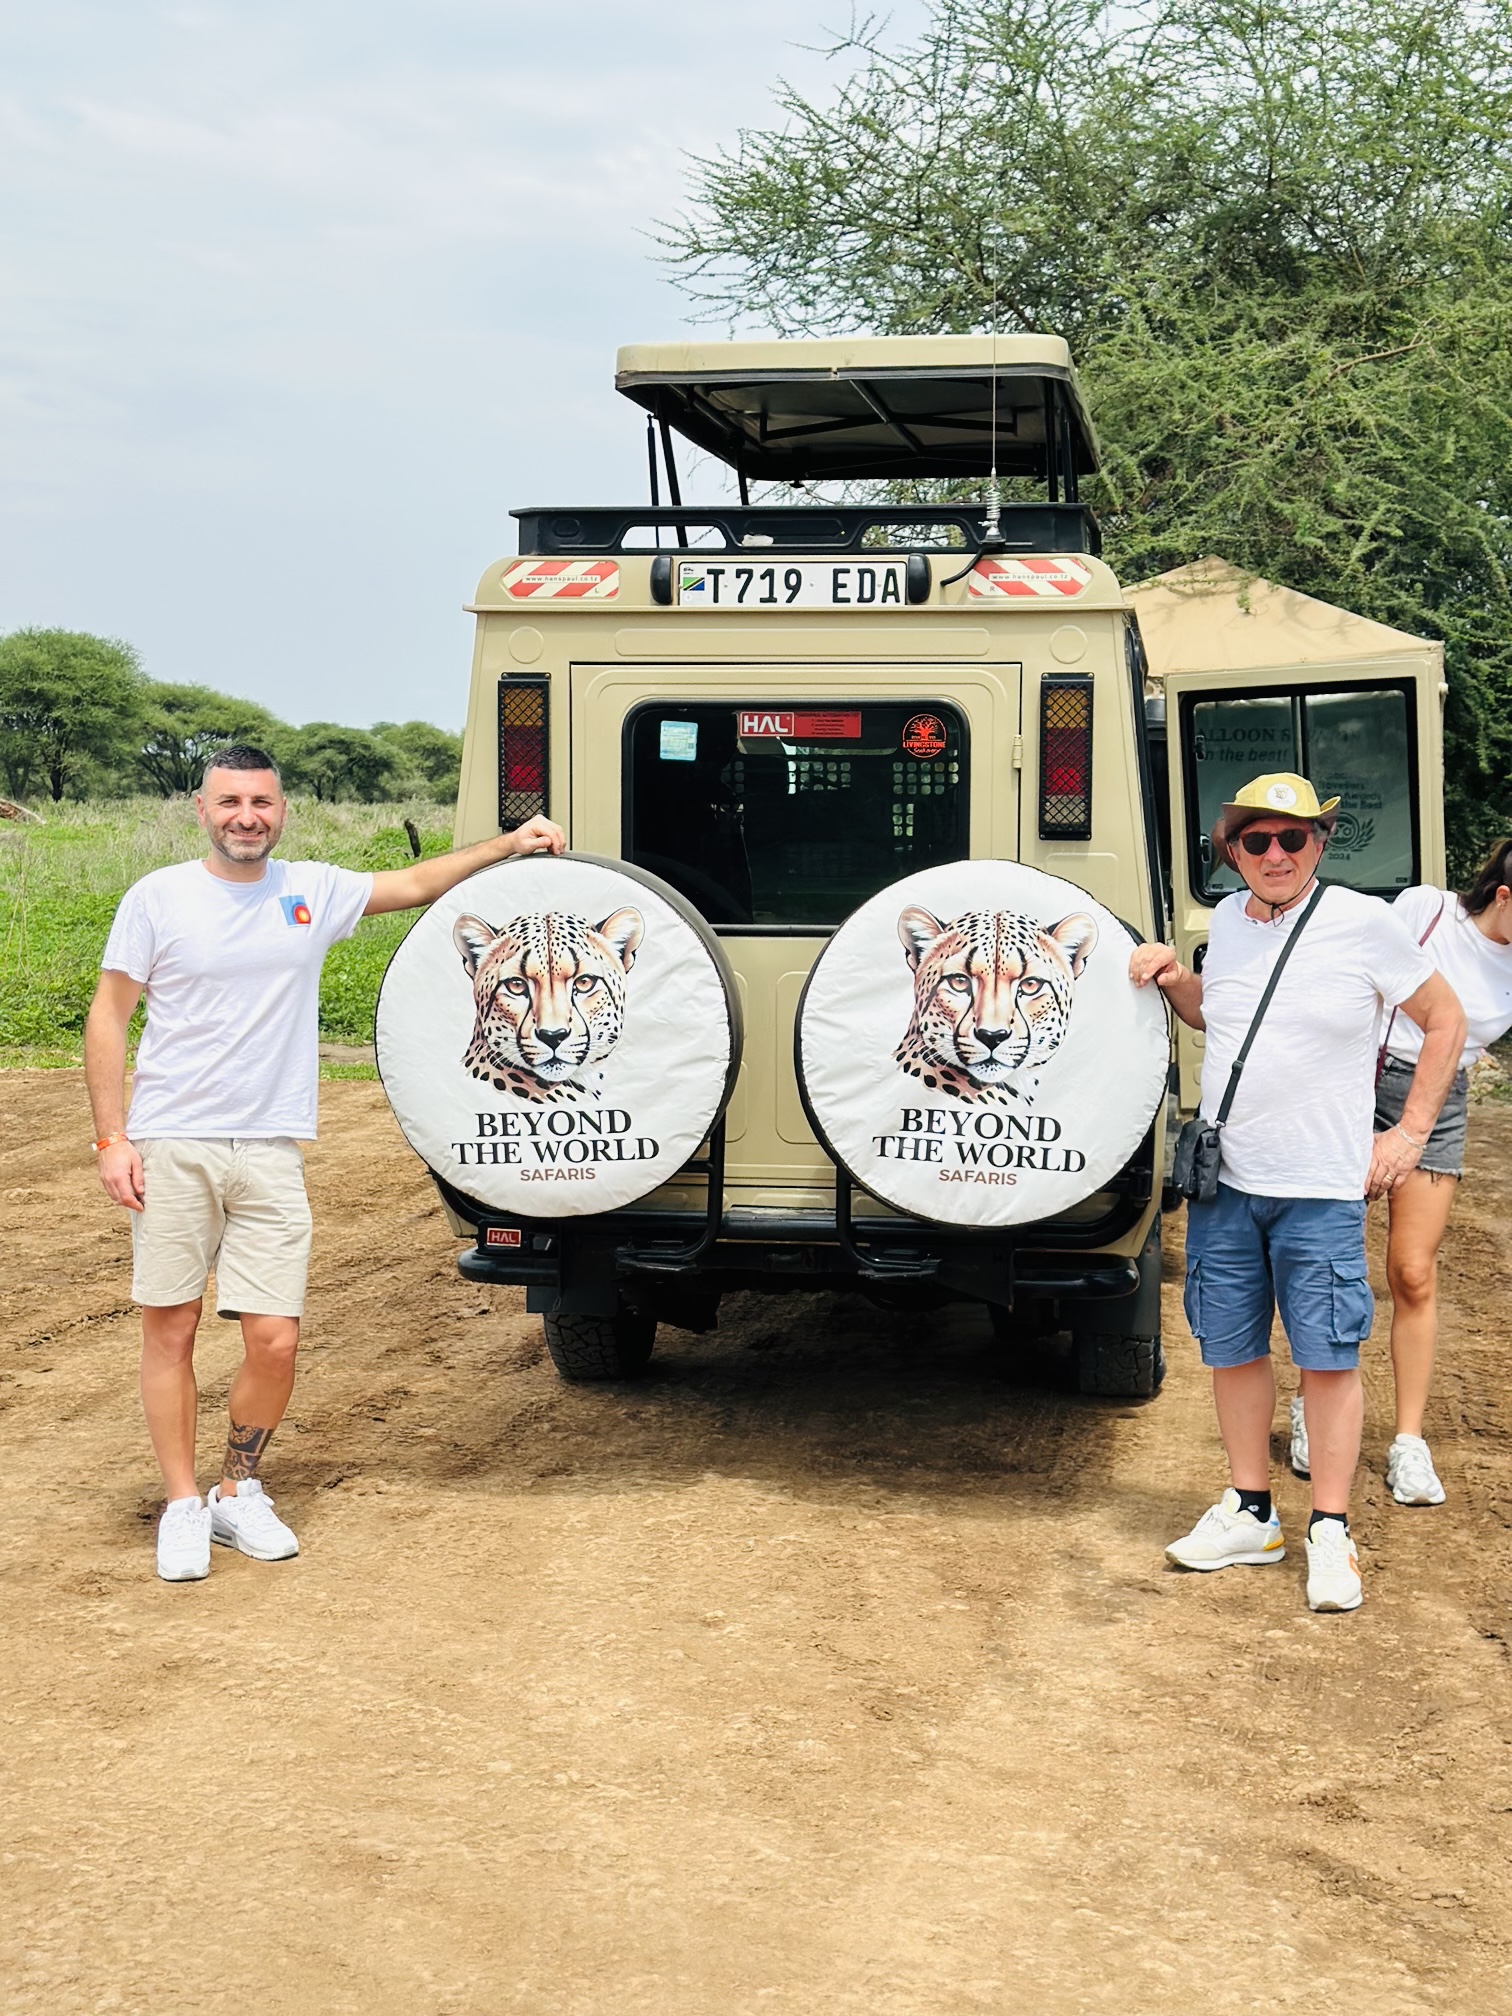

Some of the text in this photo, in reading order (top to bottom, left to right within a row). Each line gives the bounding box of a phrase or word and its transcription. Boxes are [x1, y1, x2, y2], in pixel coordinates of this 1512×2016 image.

[832, 568, 901, 603] EDA
[743, 715, 789, 733] HAL
[1219, 747, 1244, 761] the
[1328, 852, 1351, 860] 2024
[475, 1109, 632, 1138] BEYOND
[900, 1108, 1062, 1142] BEYOND
[451, 1137, 660, 1165] THE WORLD
[872, 1135, 1086, 1173] THE WORLD
[520, 1167, 596, 1181] SAFARIS
[939, 1169, 1017, 1186] SAFARIS
[491, 1231, 517, 1243] HAL
